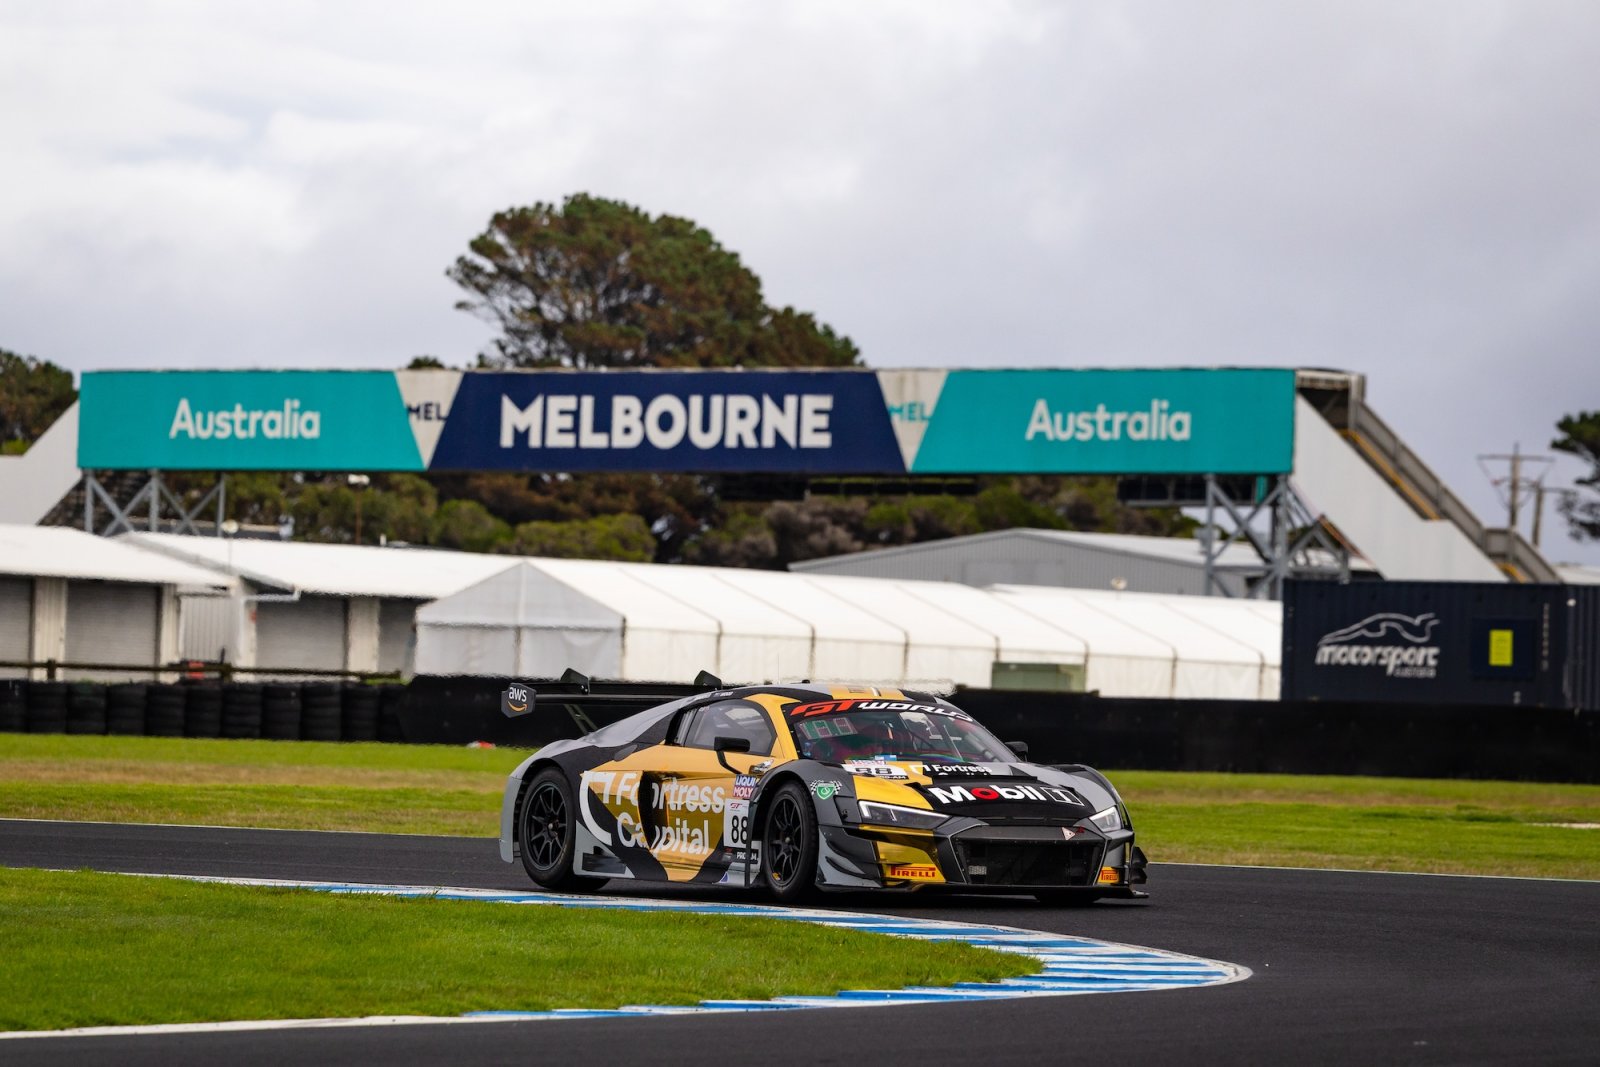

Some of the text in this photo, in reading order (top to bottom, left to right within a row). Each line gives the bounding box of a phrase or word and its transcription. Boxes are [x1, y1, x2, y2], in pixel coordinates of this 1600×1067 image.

[169, 398, 321, 440] Australia
[500, 394, 833, 450] MELBOURNE
[1025, 398, 1192, 442] Australia
[508, 687, 527, 703] aws
[932, 764, 992, 773] Fortress
[735, 776, 755, 787] LIQUI
[615, 772, 724, 815] Fortress
[733, 786, 753, 797] MOLY
[927, 785, 1047, 804] Mobil
[731, 815, 749, 844] 88
[890, 866, 937, 878] PIRELLI
